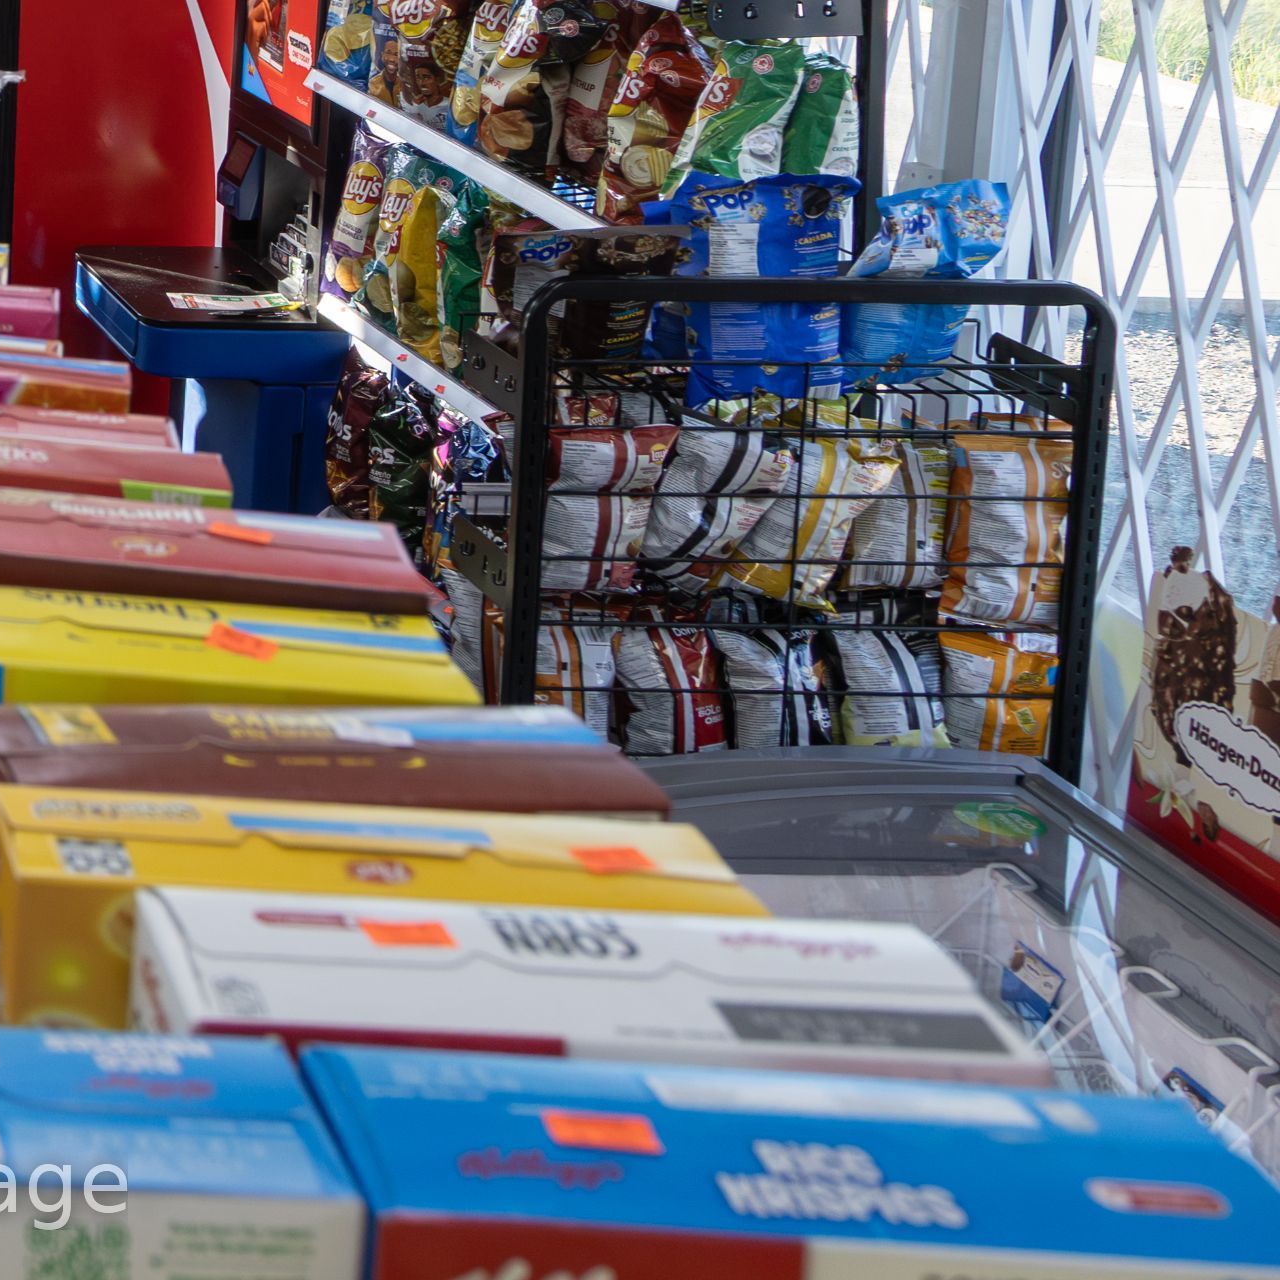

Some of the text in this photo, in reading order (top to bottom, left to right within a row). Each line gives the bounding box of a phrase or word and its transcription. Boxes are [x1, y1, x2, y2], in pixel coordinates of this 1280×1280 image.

[344, 169, 383, 200] Lay's
[701, 188, 754, 217] POP
[519, 239, 573, 263] POP
[797, 232, 834, 247] CANADA
